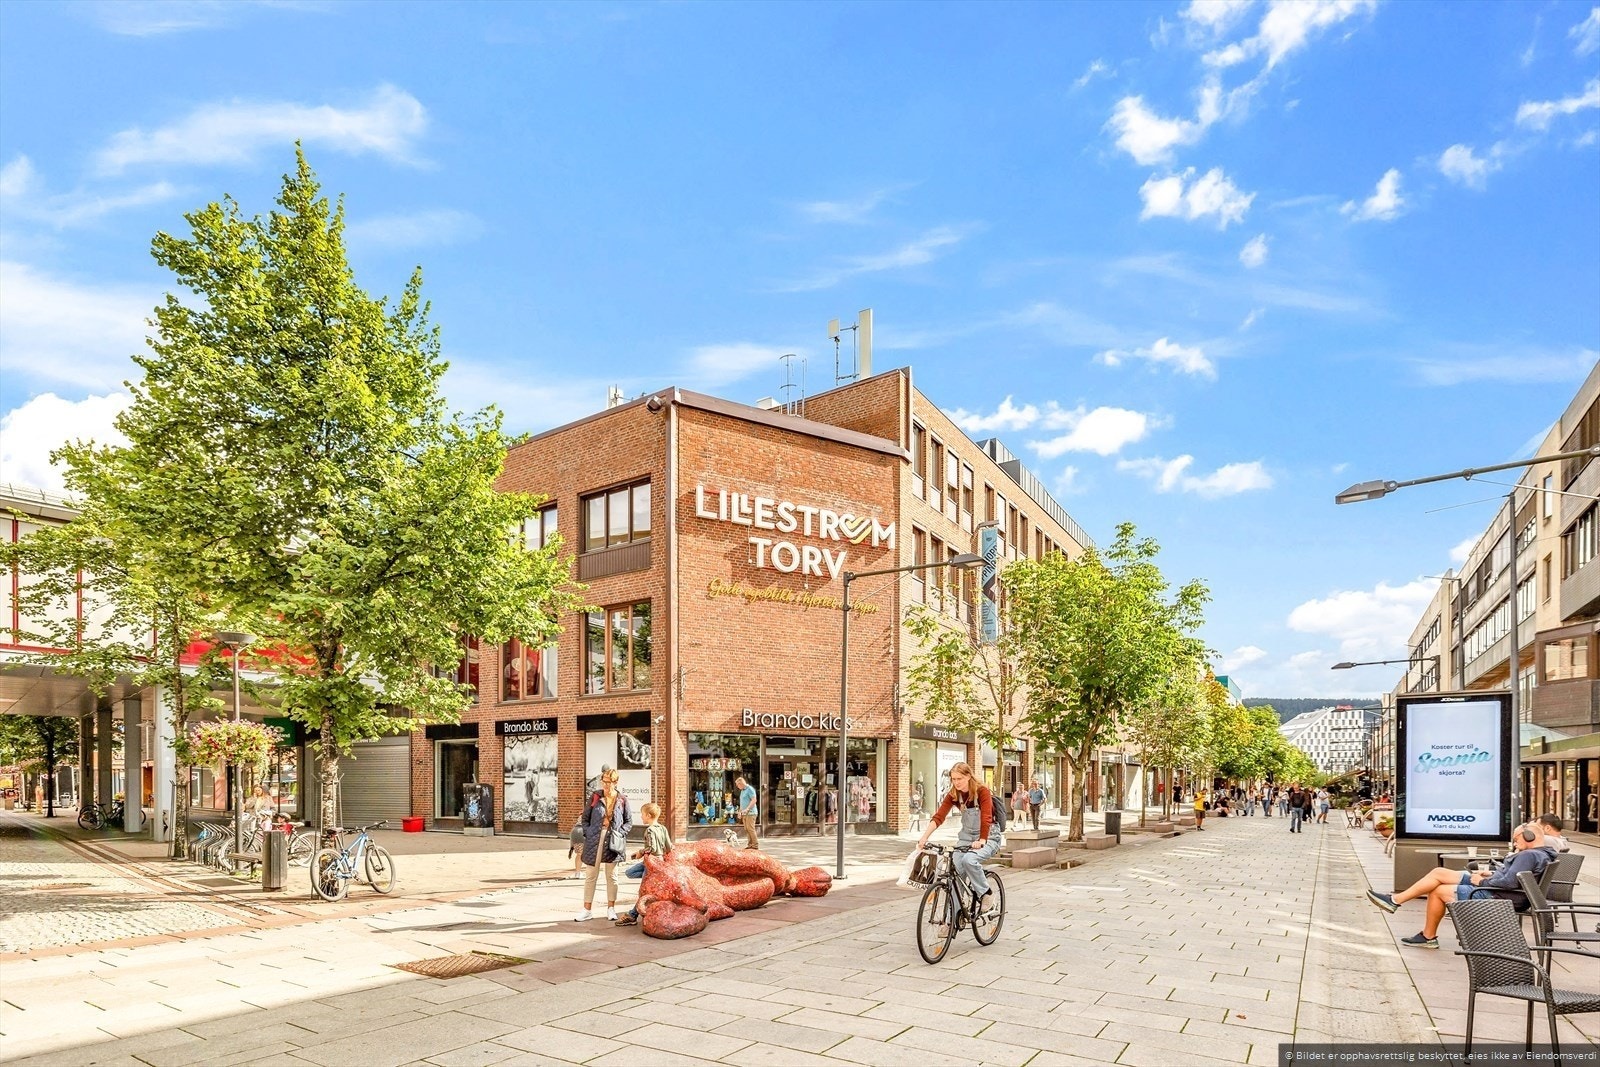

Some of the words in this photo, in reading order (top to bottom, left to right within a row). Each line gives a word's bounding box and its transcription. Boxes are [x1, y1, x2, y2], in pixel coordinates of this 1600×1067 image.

[748, 536, 847, 580] TORV
[708, 577, 741, 598] Gode
[504, 722, 532, 733] Brando
[532, 721, 549, 732] kids
[742, 708, 813, 730] Brando
[819, 711, 853, 731] kids
[1414, 747, 1494, 773] Spania
[1427, 814, 1476, 822] MAXBO
